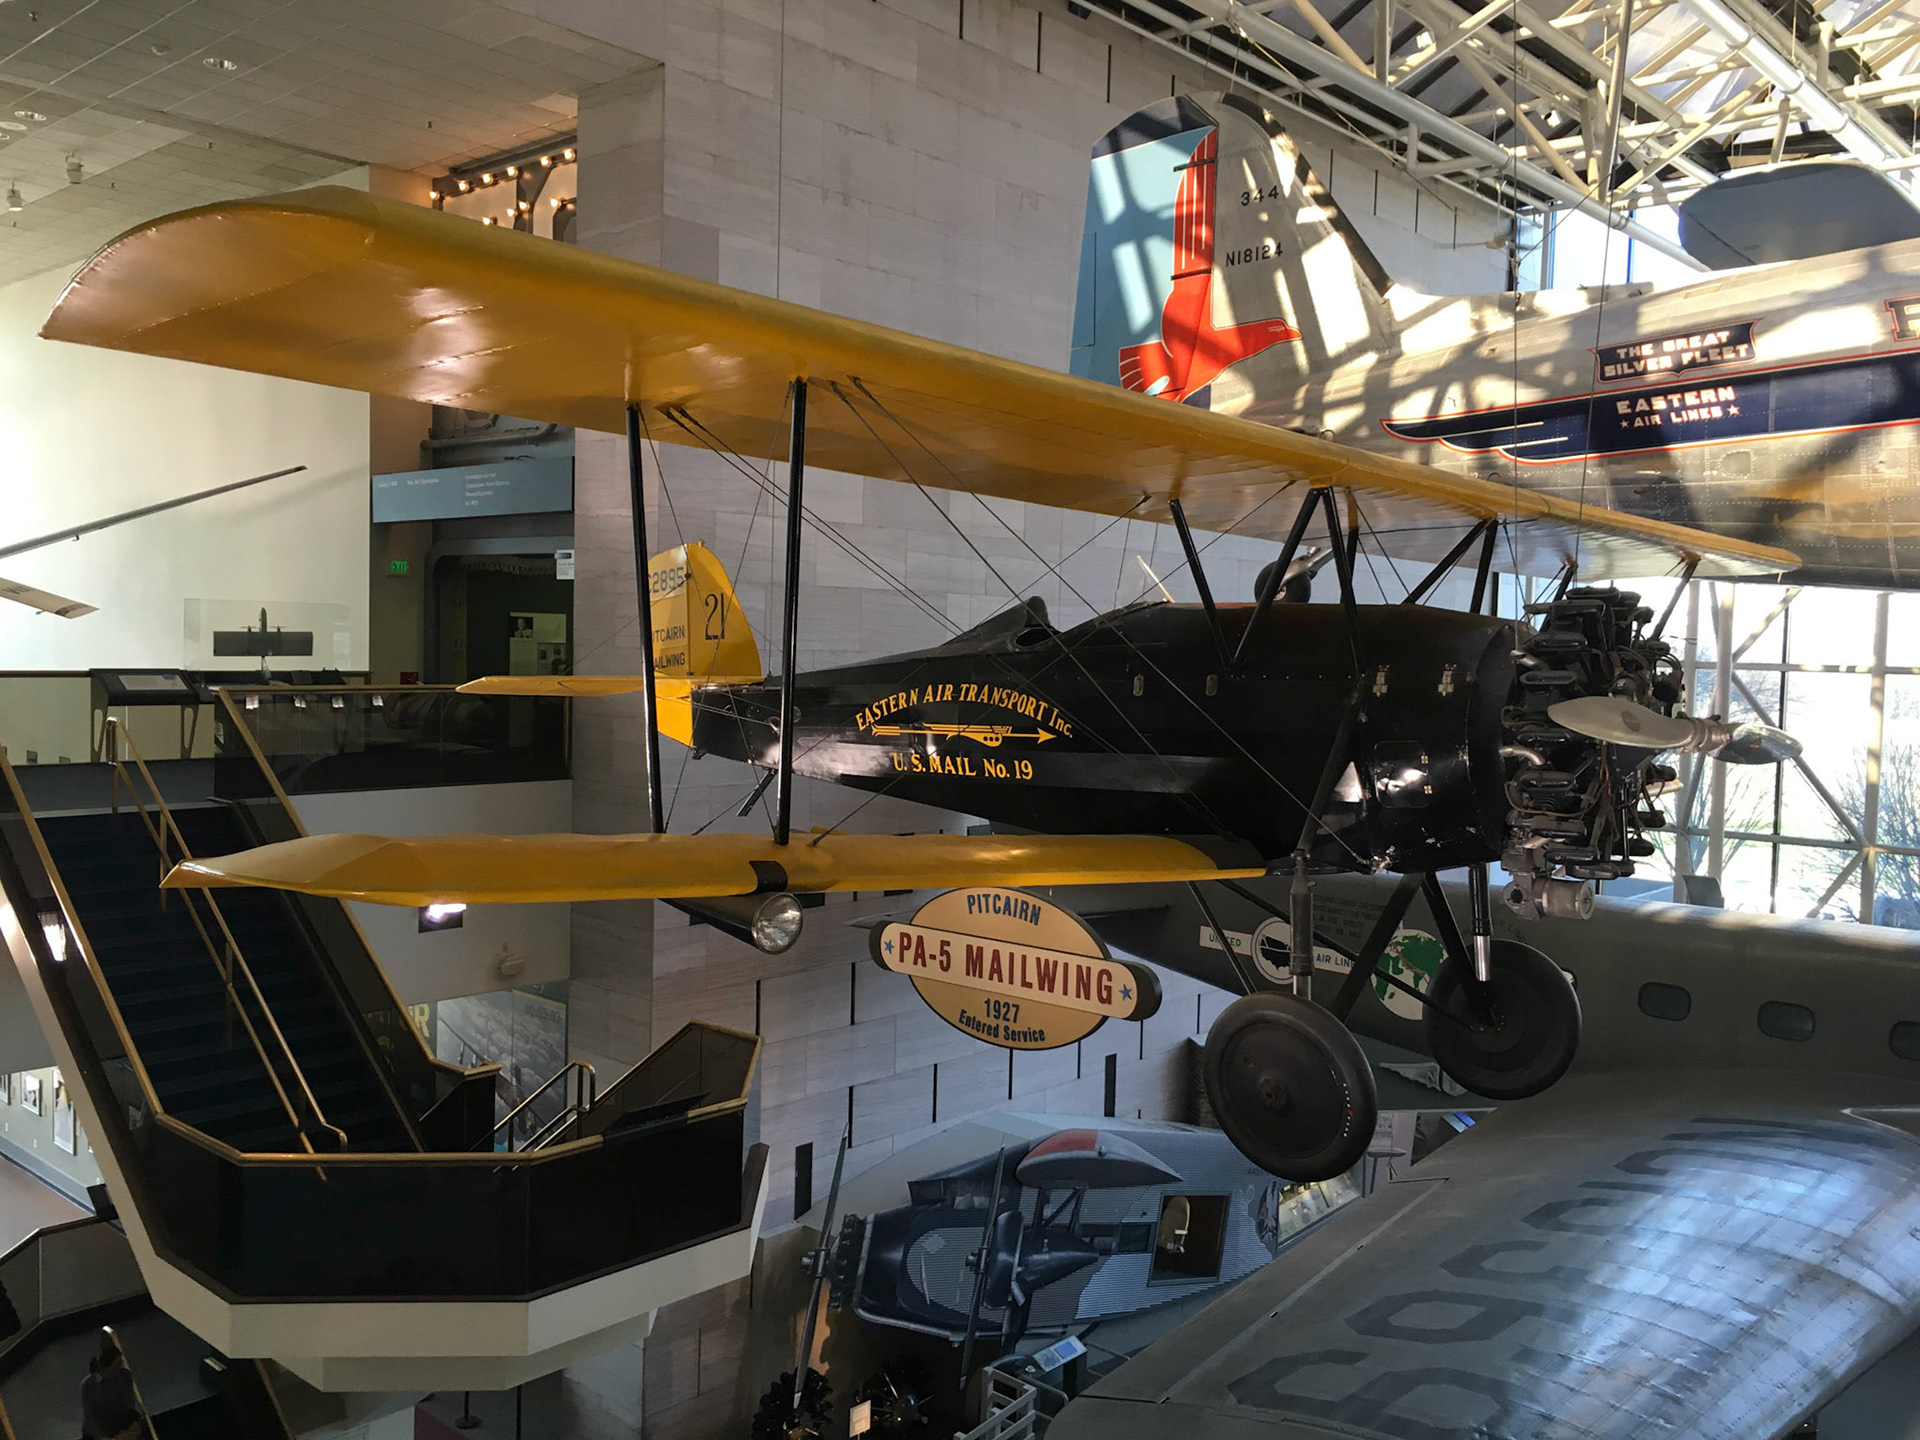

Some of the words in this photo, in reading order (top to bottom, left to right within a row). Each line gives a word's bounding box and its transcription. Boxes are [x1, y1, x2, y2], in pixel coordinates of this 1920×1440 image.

[1241, 185, 1279, 206] 344
[1226, 242, 1283, 267] N18124
[1616, 343, 1654, 360] THE
[1662, 331, 1730, 353] GREAT
[1604, 356, 1673, 378] SILVER
[1681, 344, 1750, 366] FLEET
[1616, 385, 1736, 415] EASTERN
[1633, 414, 1662, 428] AIR
[1670, 406, 1724, 424] LINES
[704, 592, 726, 641] 21
[652, 625, 685, 643] ITCAIRN
[654, 652, 686, 669] AILWING
[855, 688, 920, 731] EASTERN
[923, 683, 954, 704] AIR
[959, 683, 1049, 721] TRANSPORT
[1049, 708, 1074, 739] Inc.
[929, 755, 977, 777] MAIL
[983, 758, 1011, 779] No.
[1013, 760, 1034, 780] 19
[966, 893, 1042, 926] PITCAIRN
[898, 932, 951, 972] PA-5
[965, 944, 1113, 1006] MAILWING
[1316, 953, 1332, 964] AIR
[1335, 956, 1356, 968] LINE
[984, 997, 1021, 1024] 1927
[959, 1008, 999, 1039] Entered
[1003, 1026, 1046, 1043] Service
